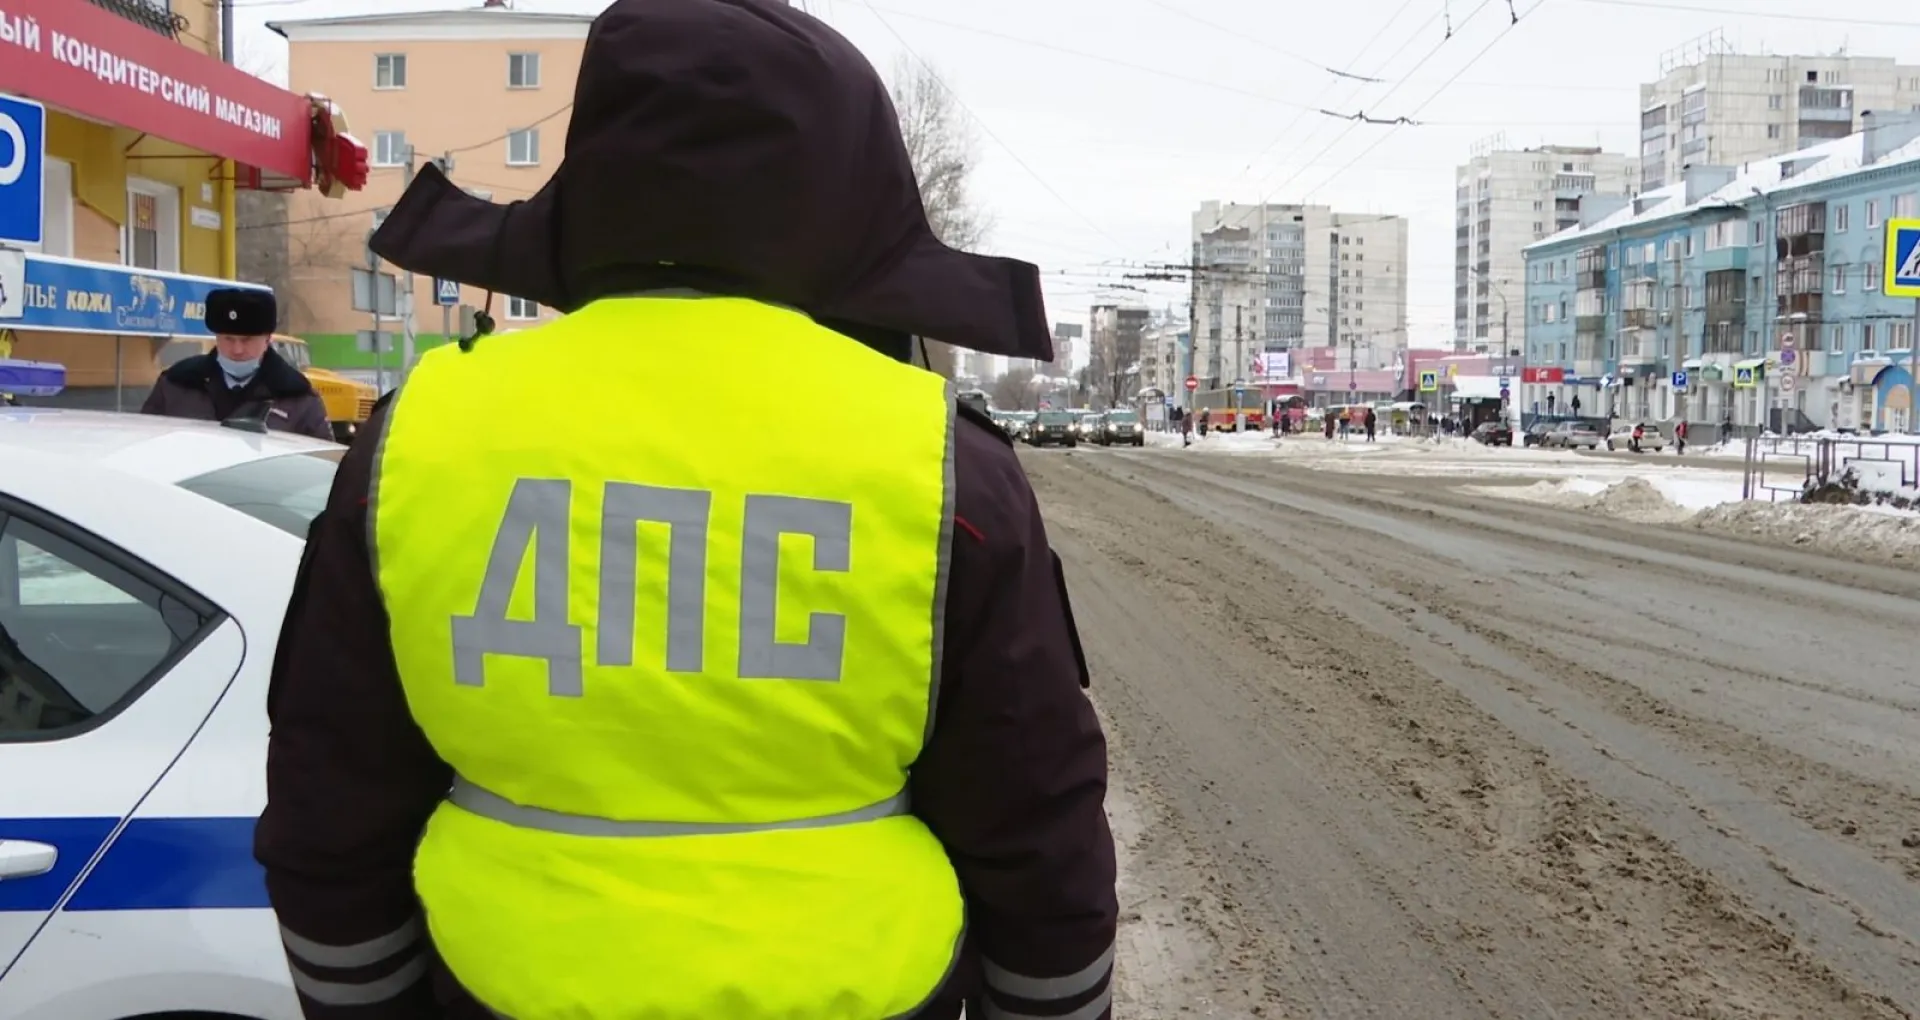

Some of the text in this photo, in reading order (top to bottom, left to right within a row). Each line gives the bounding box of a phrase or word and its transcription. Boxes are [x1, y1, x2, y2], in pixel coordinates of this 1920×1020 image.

[51, 30, 210, 115] КОНДИТЕРСКИЙ
[215, 95, 281, 140] МАГАЗИН
[66, 289, 113, 313] КОЖА
[450, 477, 853, 697] ДПС
